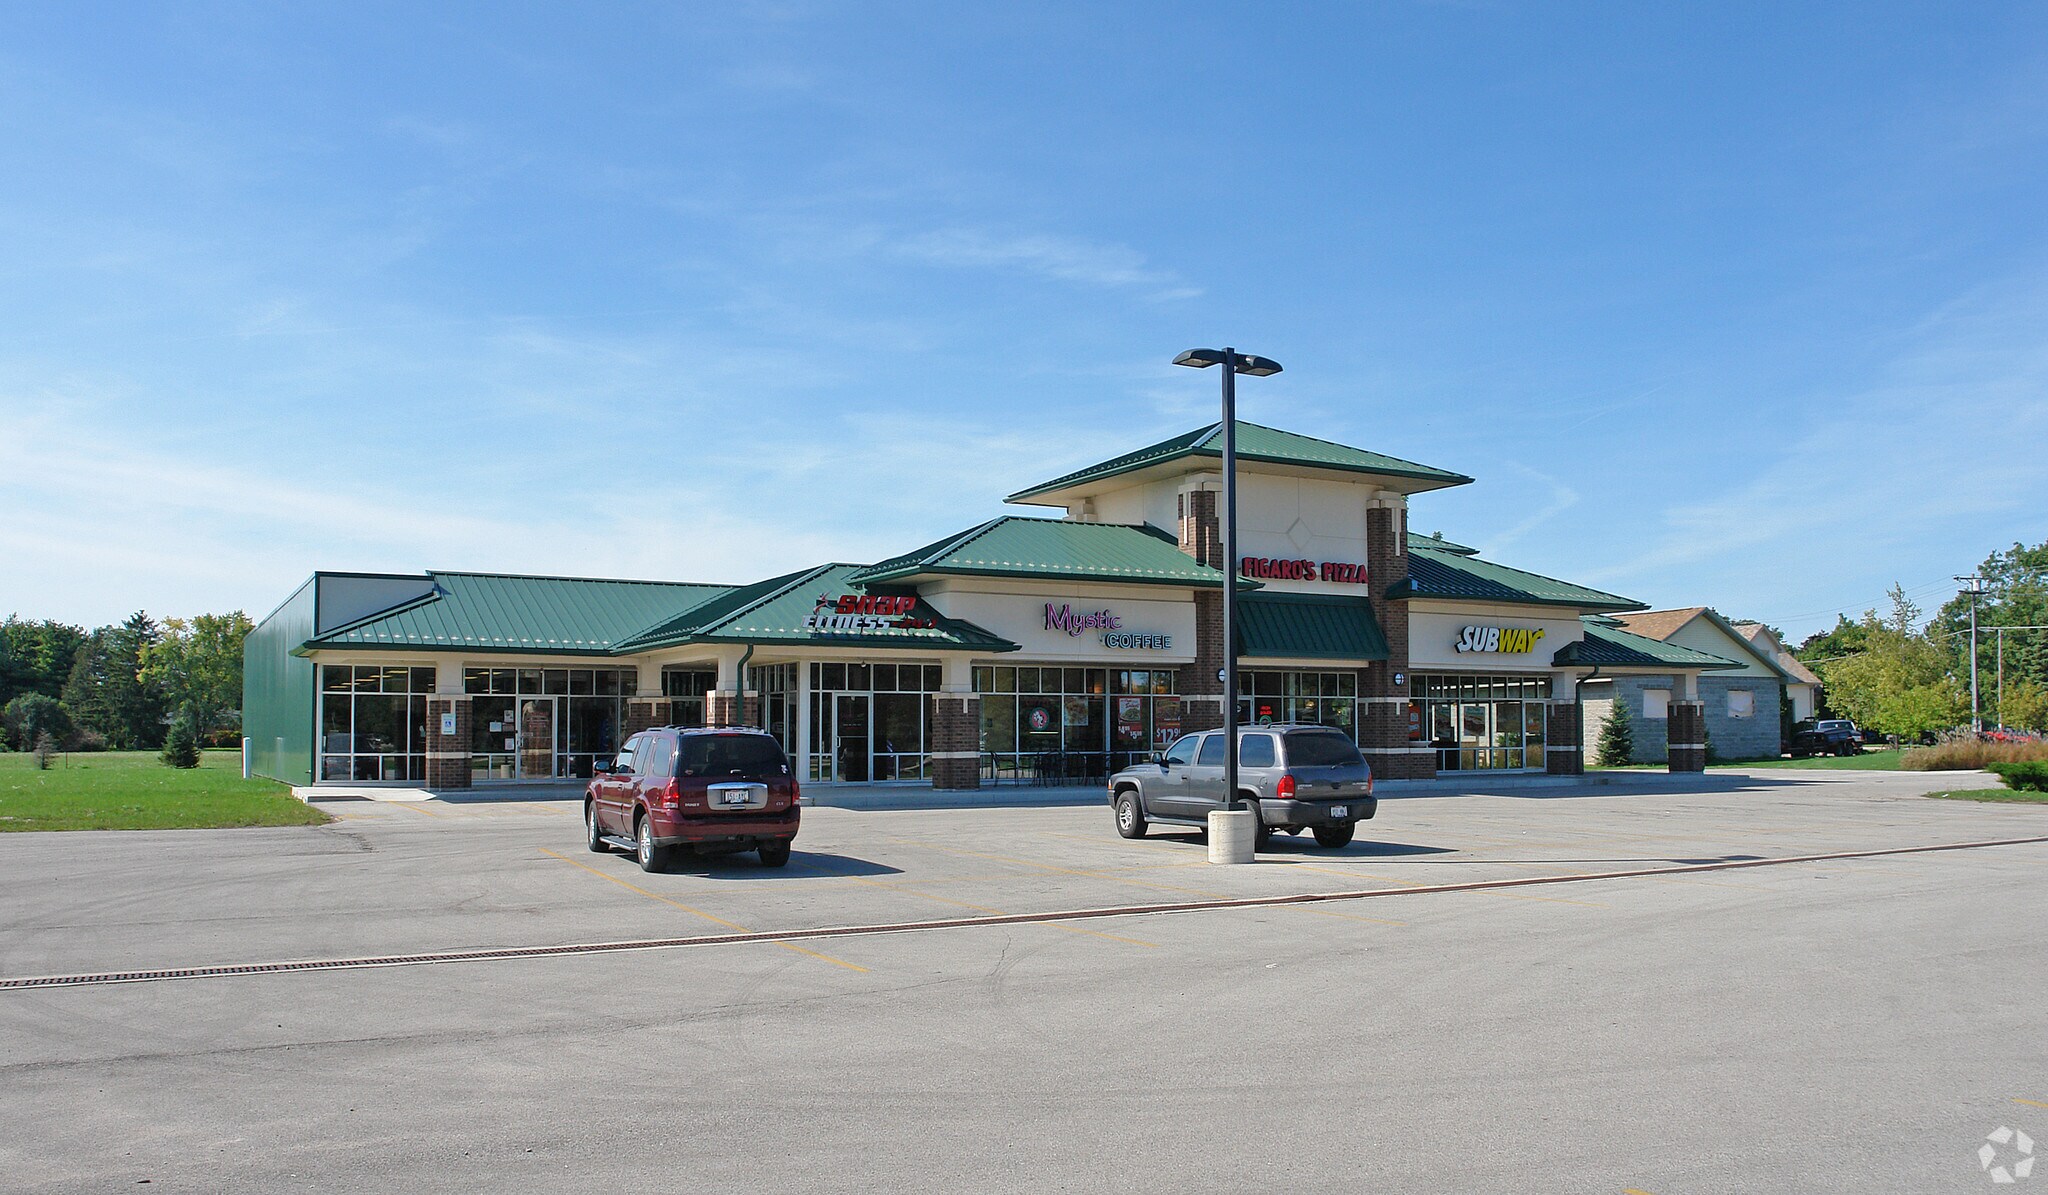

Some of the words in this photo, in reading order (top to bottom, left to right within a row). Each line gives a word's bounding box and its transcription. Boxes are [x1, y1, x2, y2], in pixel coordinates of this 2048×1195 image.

[1242, 557, 1316, 580] FIGARO'S
[1321, 562, 1368, 583] PIZZA
[802, 615, 891, 629] FITNESS
[1045, 602, 1122, 637] Mystic
[1105, 633, 1172, 649] COFFEE
[1456, 626, 1545, 653] SUBWAY
